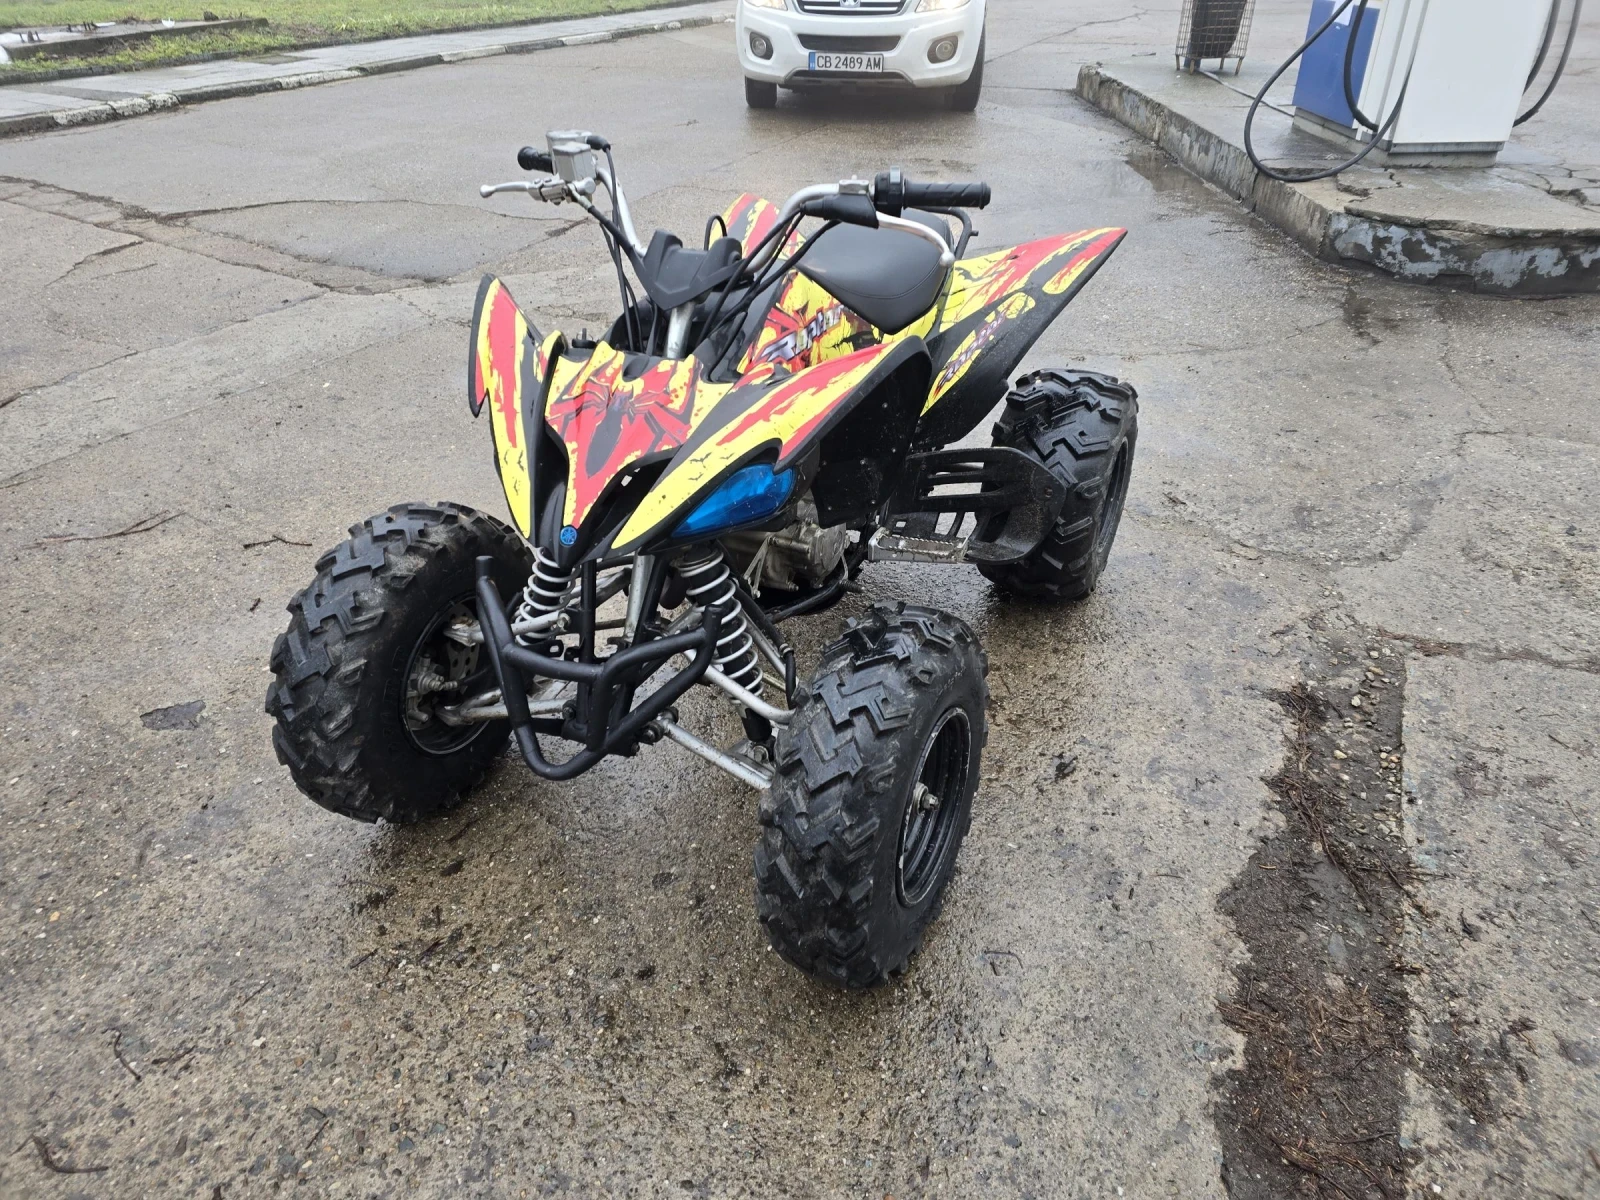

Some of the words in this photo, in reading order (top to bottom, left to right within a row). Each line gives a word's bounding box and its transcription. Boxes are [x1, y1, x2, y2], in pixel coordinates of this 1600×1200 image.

[816, 55, 832, 69] CB
[834, 56, 863, 70] 2489
[865, 57, 881, 70] AM
